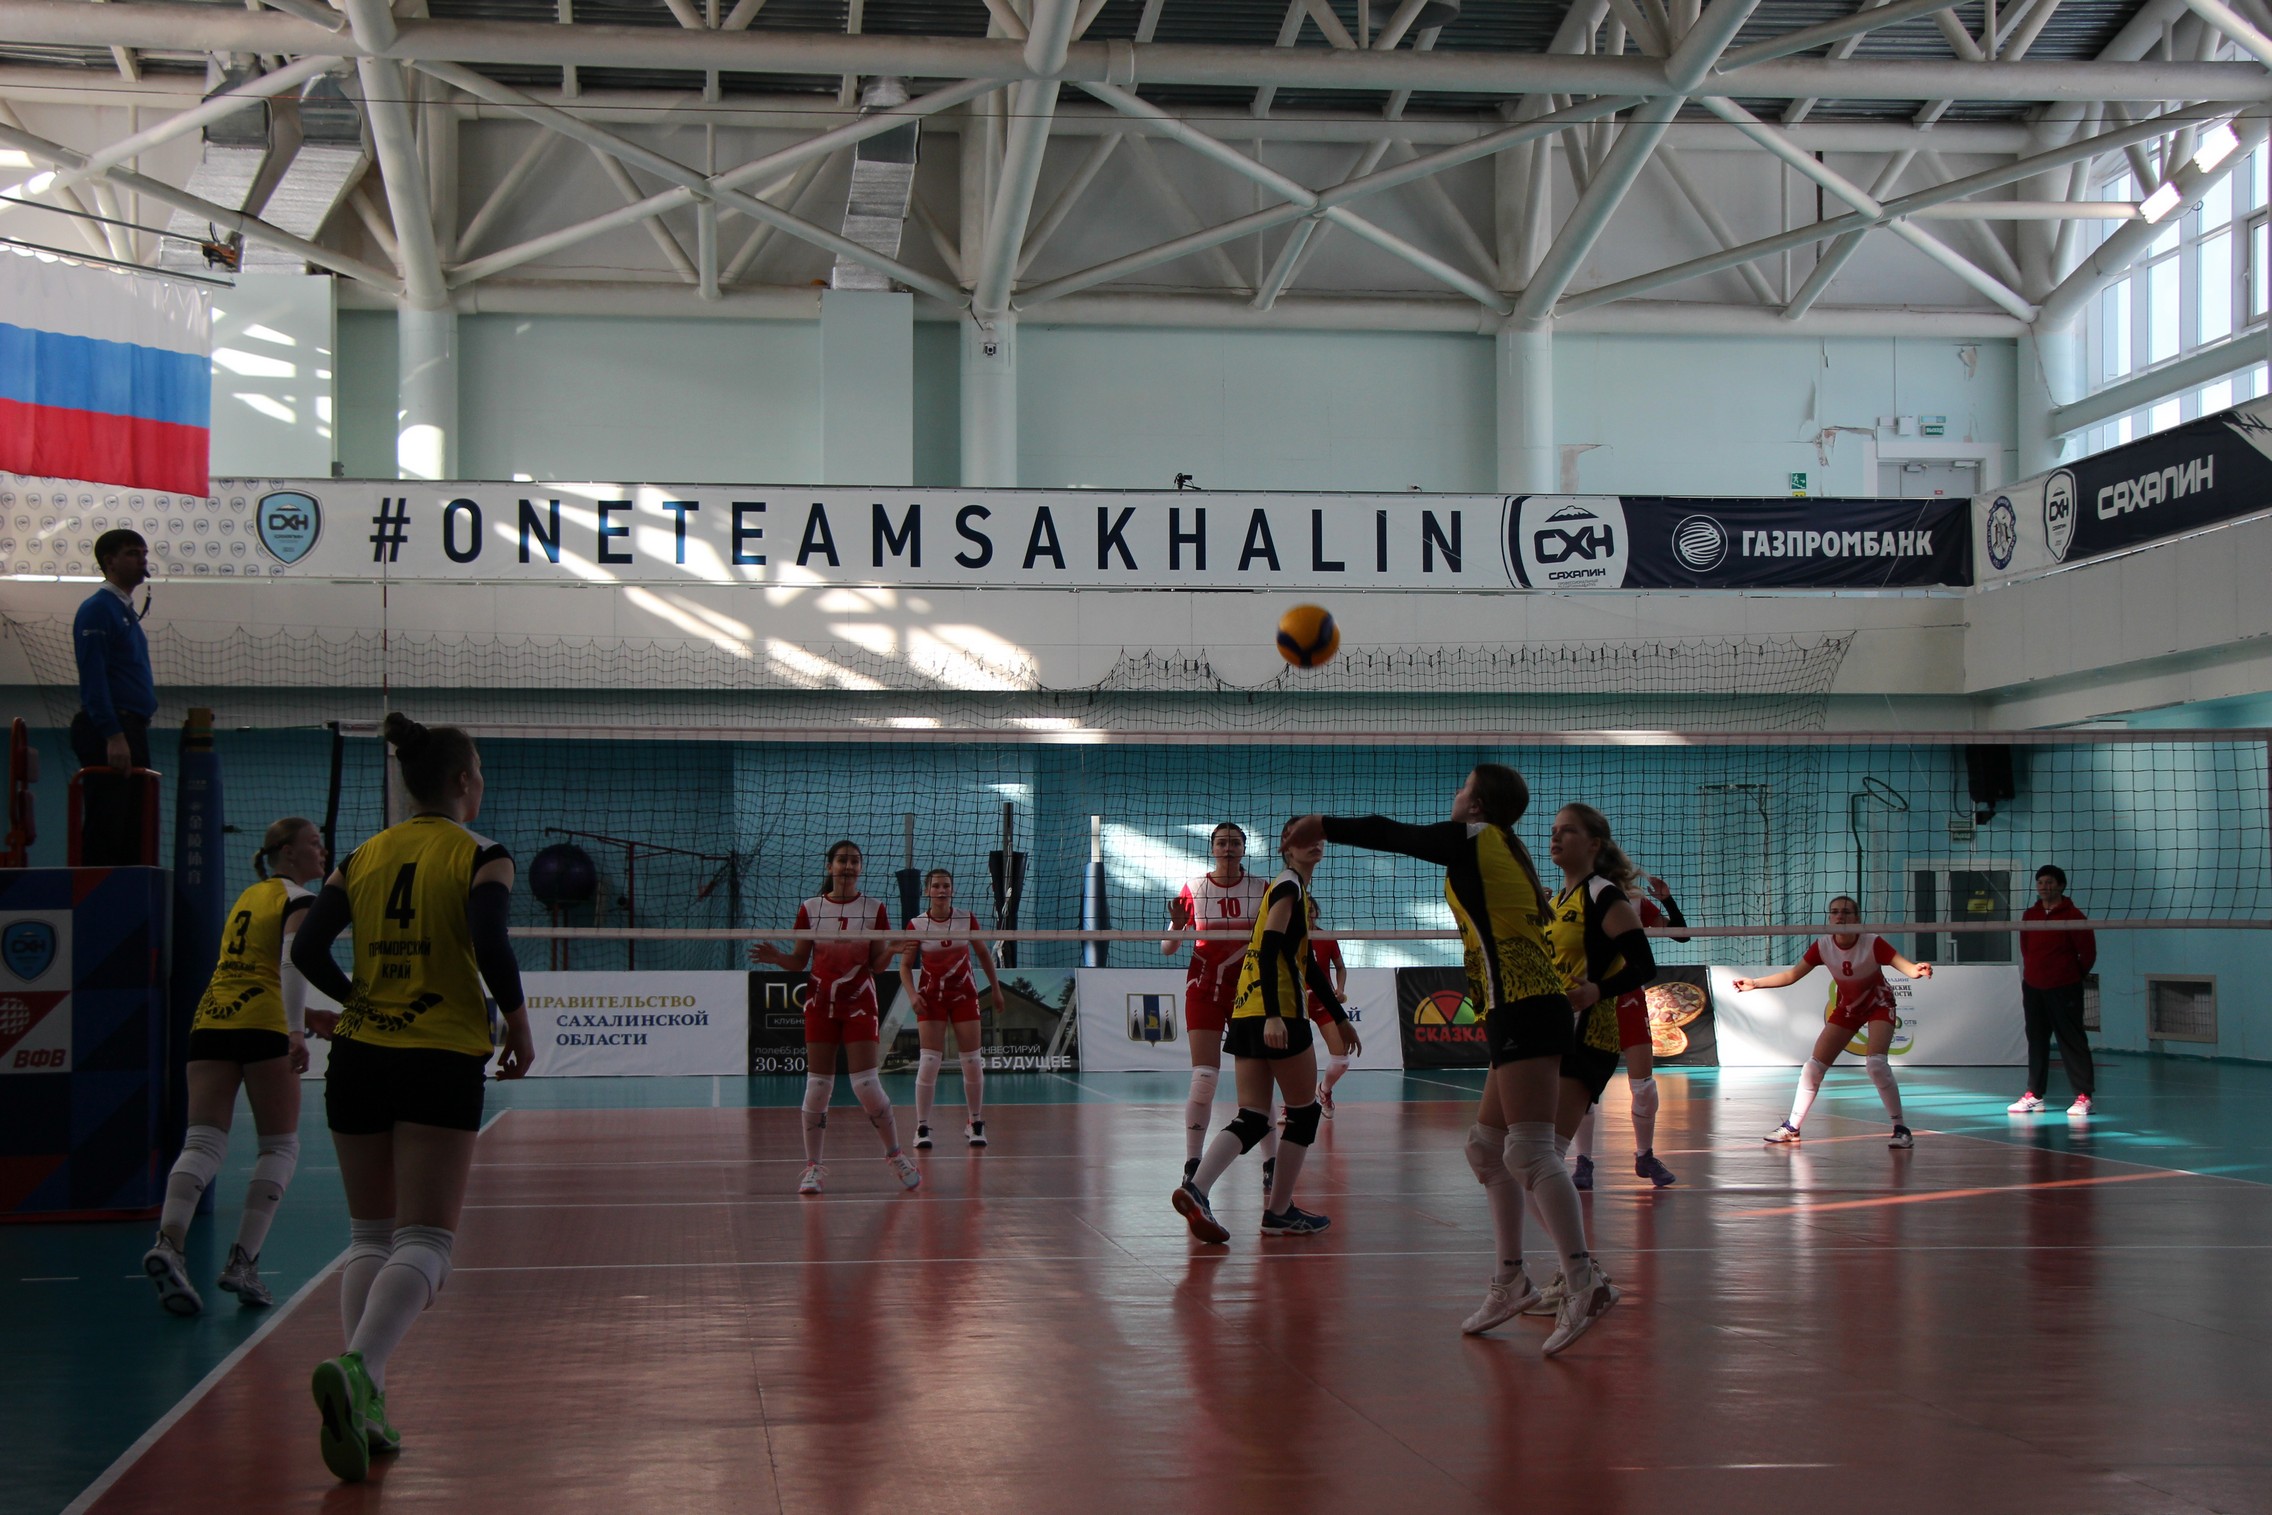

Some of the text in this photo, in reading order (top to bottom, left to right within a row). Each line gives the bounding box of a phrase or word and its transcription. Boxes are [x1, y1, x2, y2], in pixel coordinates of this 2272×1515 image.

[2097, 454, 2214, 521] САХАЛИН
[369, 497, 1462, 573] #ONETEAMSAKHALIN
[1742, 530, 1934, 558] ГАЗПРОМБАНК
[1548, 568, 1606, 580] САХАЛИН
[385, 862, 418, 929] 4
[1216, 896, 1241, 918] 10
[227, 910, 252, 955] 3
[368, 936, 431, 958] ПРИМОРСКИЙ
[382, 960, 411, 979] КРАЙ
[1842, 960, 1853, 977] 8
[527, 994, 696, 1009] ПРАВИТЕЛЬСТВО
[556, 1010, 709, 1027] САХАЛИНСКОЙ
[556, 1032, 648, 1046] ОБЛАСТИ
[1414, 1026, 1488, 1043] СКАЗКА
[13, 1049, 66, 1069] ВФВ
[991, 1056, 1072, 1071] БУДУЩЕЕ
